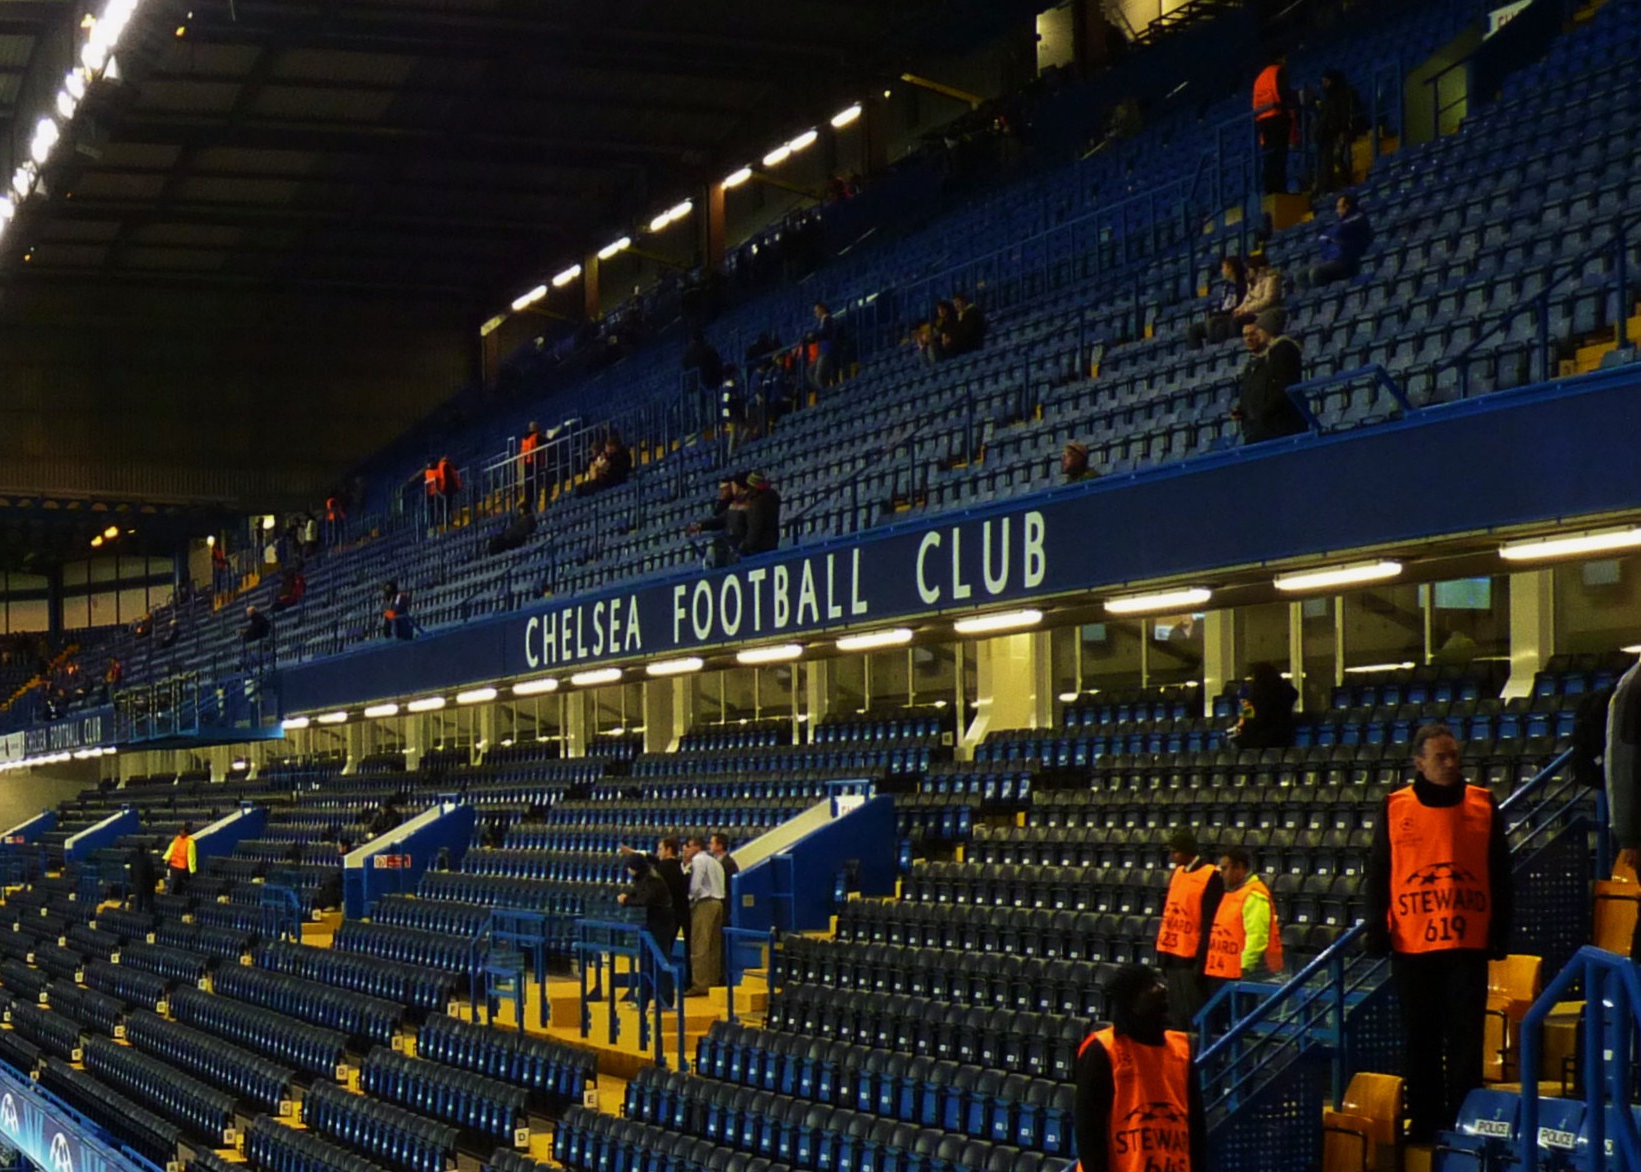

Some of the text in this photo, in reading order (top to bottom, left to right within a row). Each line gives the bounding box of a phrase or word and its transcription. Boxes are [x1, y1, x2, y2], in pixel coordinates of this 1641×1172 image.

[525, 511, 1046, 668] CHELSEA FOOTBALL CLUB
[1398, 891, 1486, 916] STEWARD
[1425, 915, 1466, 942] 619
[1477, 1121, 1510, 1135] POLICE
[1540, 1129, 1574, 1147] POLICE
